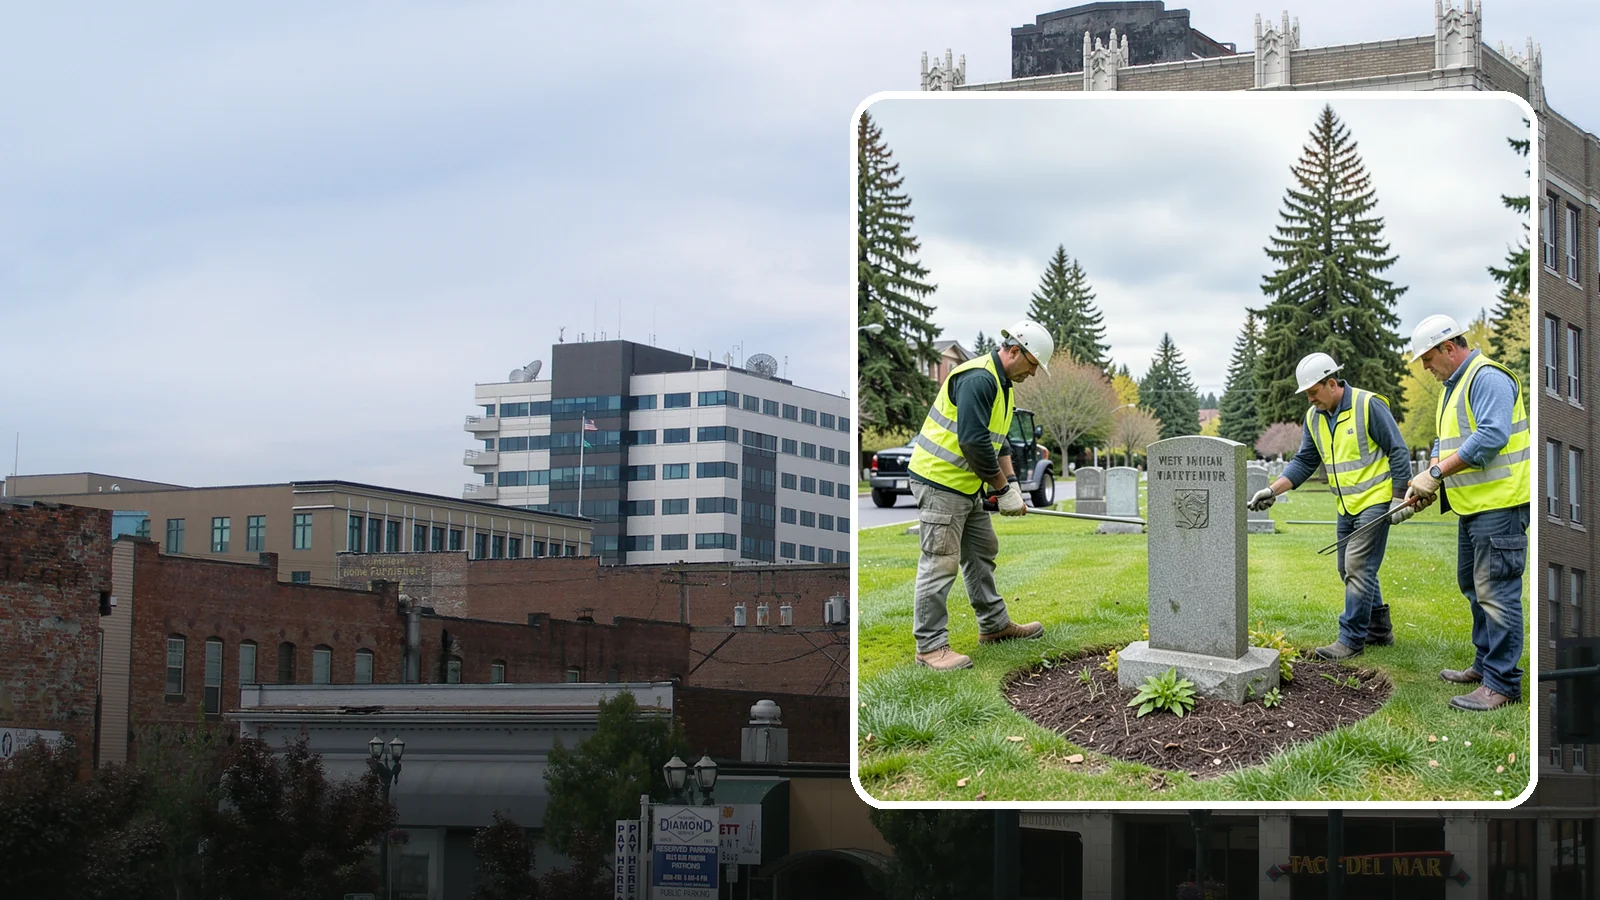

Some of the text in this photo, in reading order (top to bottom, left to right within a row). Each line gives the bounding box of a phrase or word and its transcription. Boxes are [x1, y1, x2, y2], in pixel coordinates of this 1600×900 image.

[343, 565, 427, 577] Home Furnishers
[660, 818, 713, 832] DIAMOND
[1022, 815, 1070, 828] BUILDING
[617, 825, 625, 852] PAY
[628, 824, 637, 852] PAY
[656, 845, 716, 854] RESERVED PARKING
[721, 851, 739, 862] Soup
[671, 862, 701, 870] PATRONS
[1345, 856, 1385, 875] DEL
[1392, 857, 1442, 877] MAR
[616, 856, 625, 893] HERE
[627, 856, 636, 893] HERE
[660, 888, 710, 898] PUBLIC PARKING
